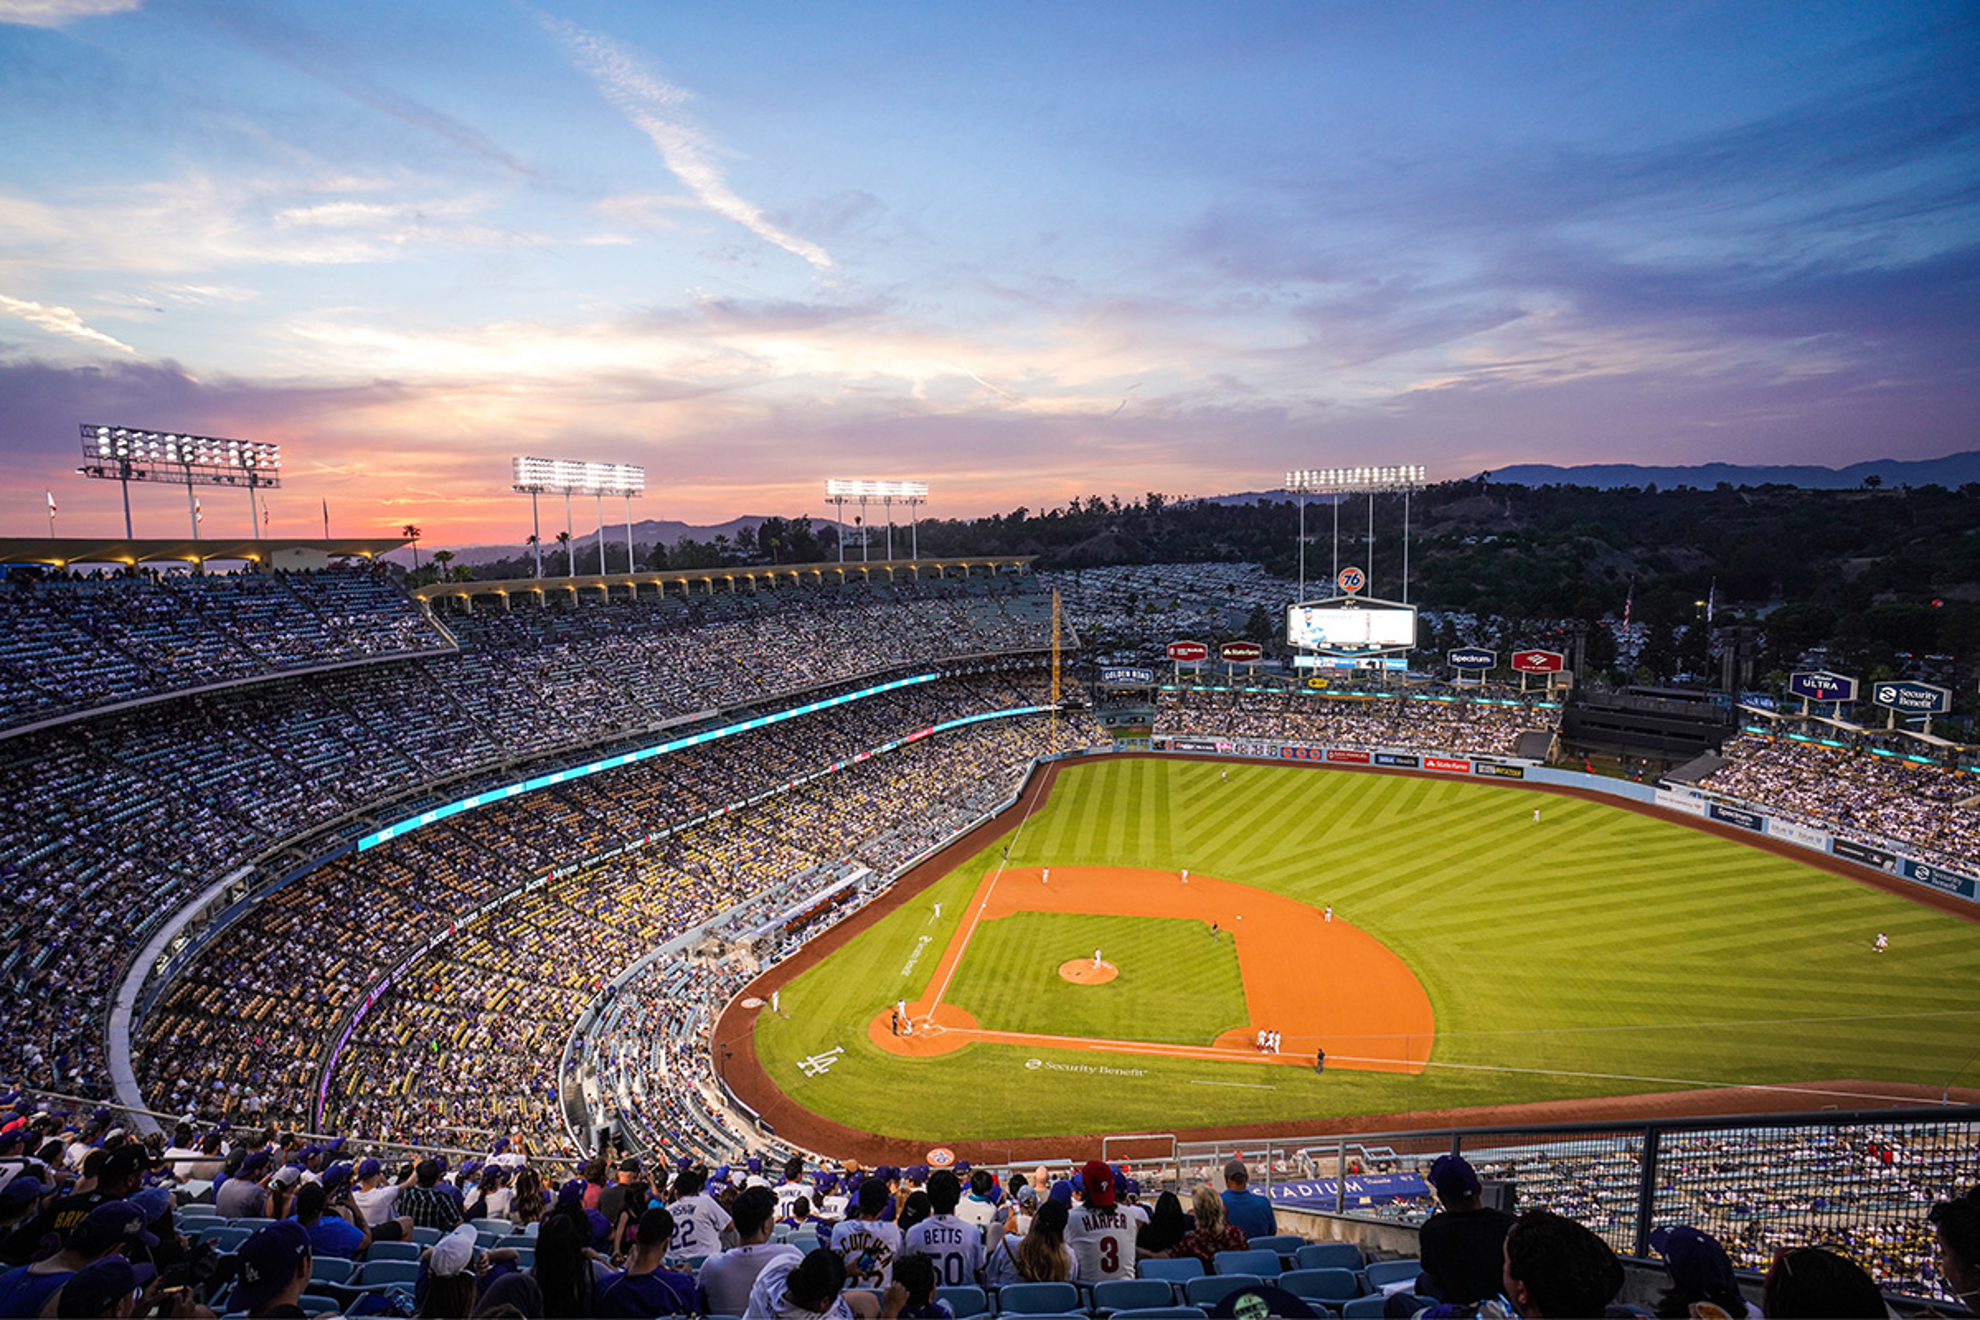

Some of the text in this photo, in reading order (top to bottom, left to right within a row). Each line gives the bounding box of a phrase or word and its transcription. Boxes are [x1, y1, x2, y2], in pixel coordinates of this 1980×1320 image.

[1343, 572, 1361, 586] 76
[1452, 654, 1489, 664] Spectrum
[1104, 670, 1131, 681] GOLDEN
[1802, 679, 1838, 691] ULTRA
[1899, 687, 1938, 702] Security
[1899, 697, 1932, 709] Benefit
[1931, 868, 1963, 887] Security
[1044, 1060, 1145, 1077] Security Benefit
[1081, 1212, 1128, 1233] HARPER
[670, 1218, 697, 1251] 22
[923, 1228, 963, 1245] BETTS
[1100, 1235, 1120, 1274] 3
[927, 1251, 964, 1286] 50
